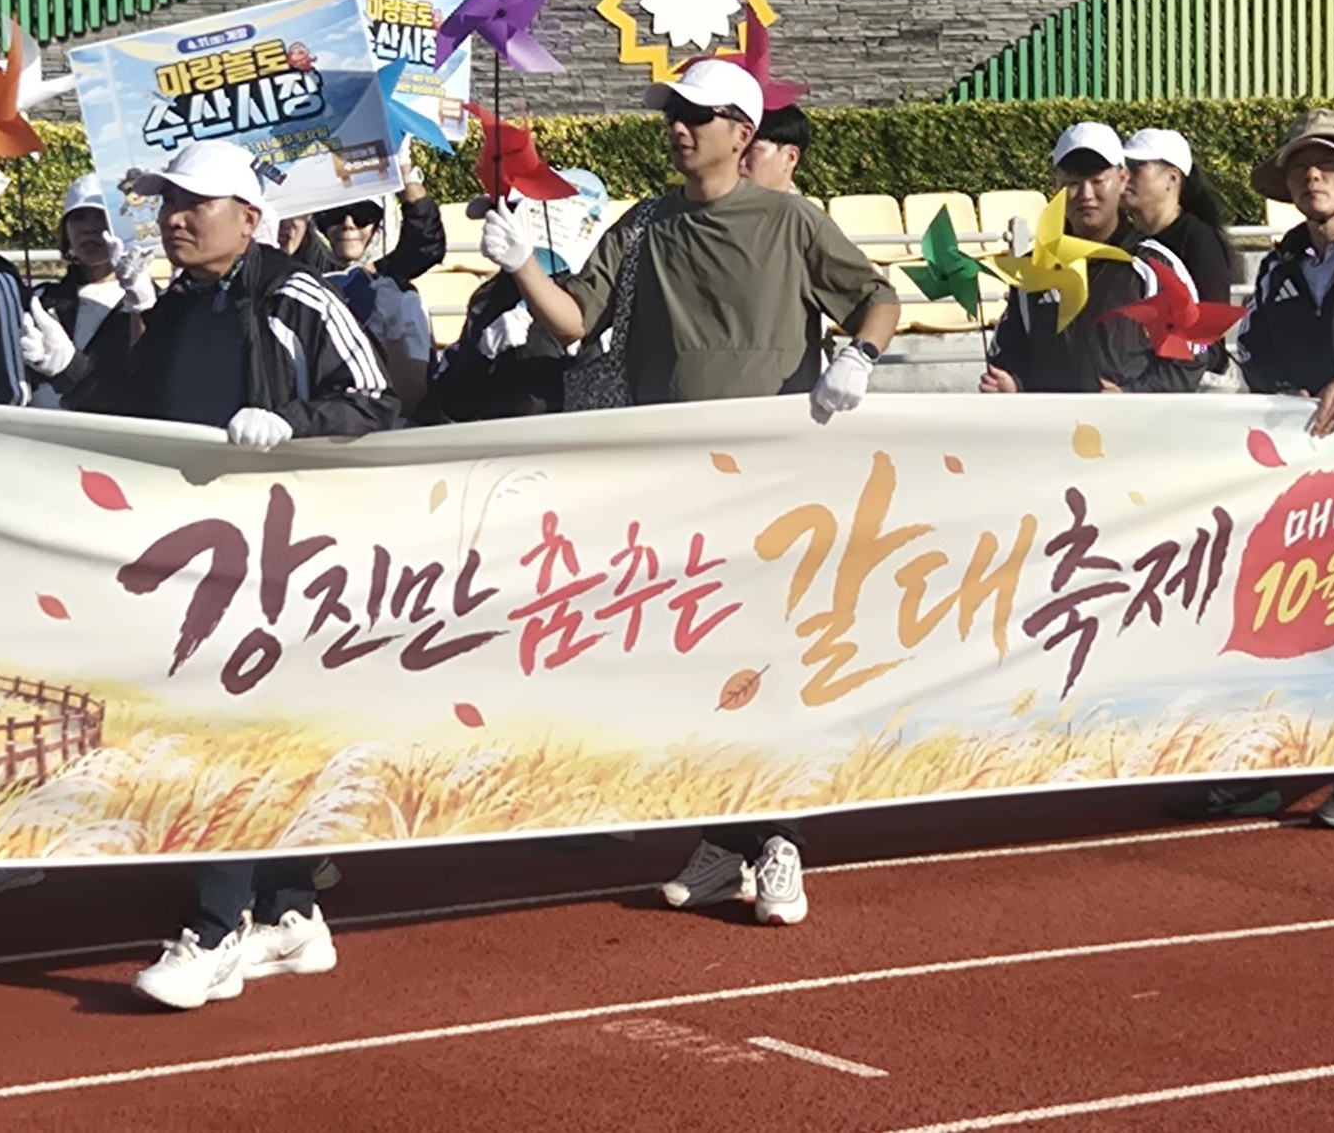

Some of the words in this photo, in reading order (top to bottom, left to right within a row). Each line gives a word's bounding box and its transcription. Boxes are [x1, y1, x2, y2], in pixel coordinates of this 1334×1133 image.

[155, 39, 291, 97] 마량놀토
[143, 69, 325, 150] 수산시장
[116, 483, 510, 695] 강진만
[507, 509, 745, 677] 춤추는
